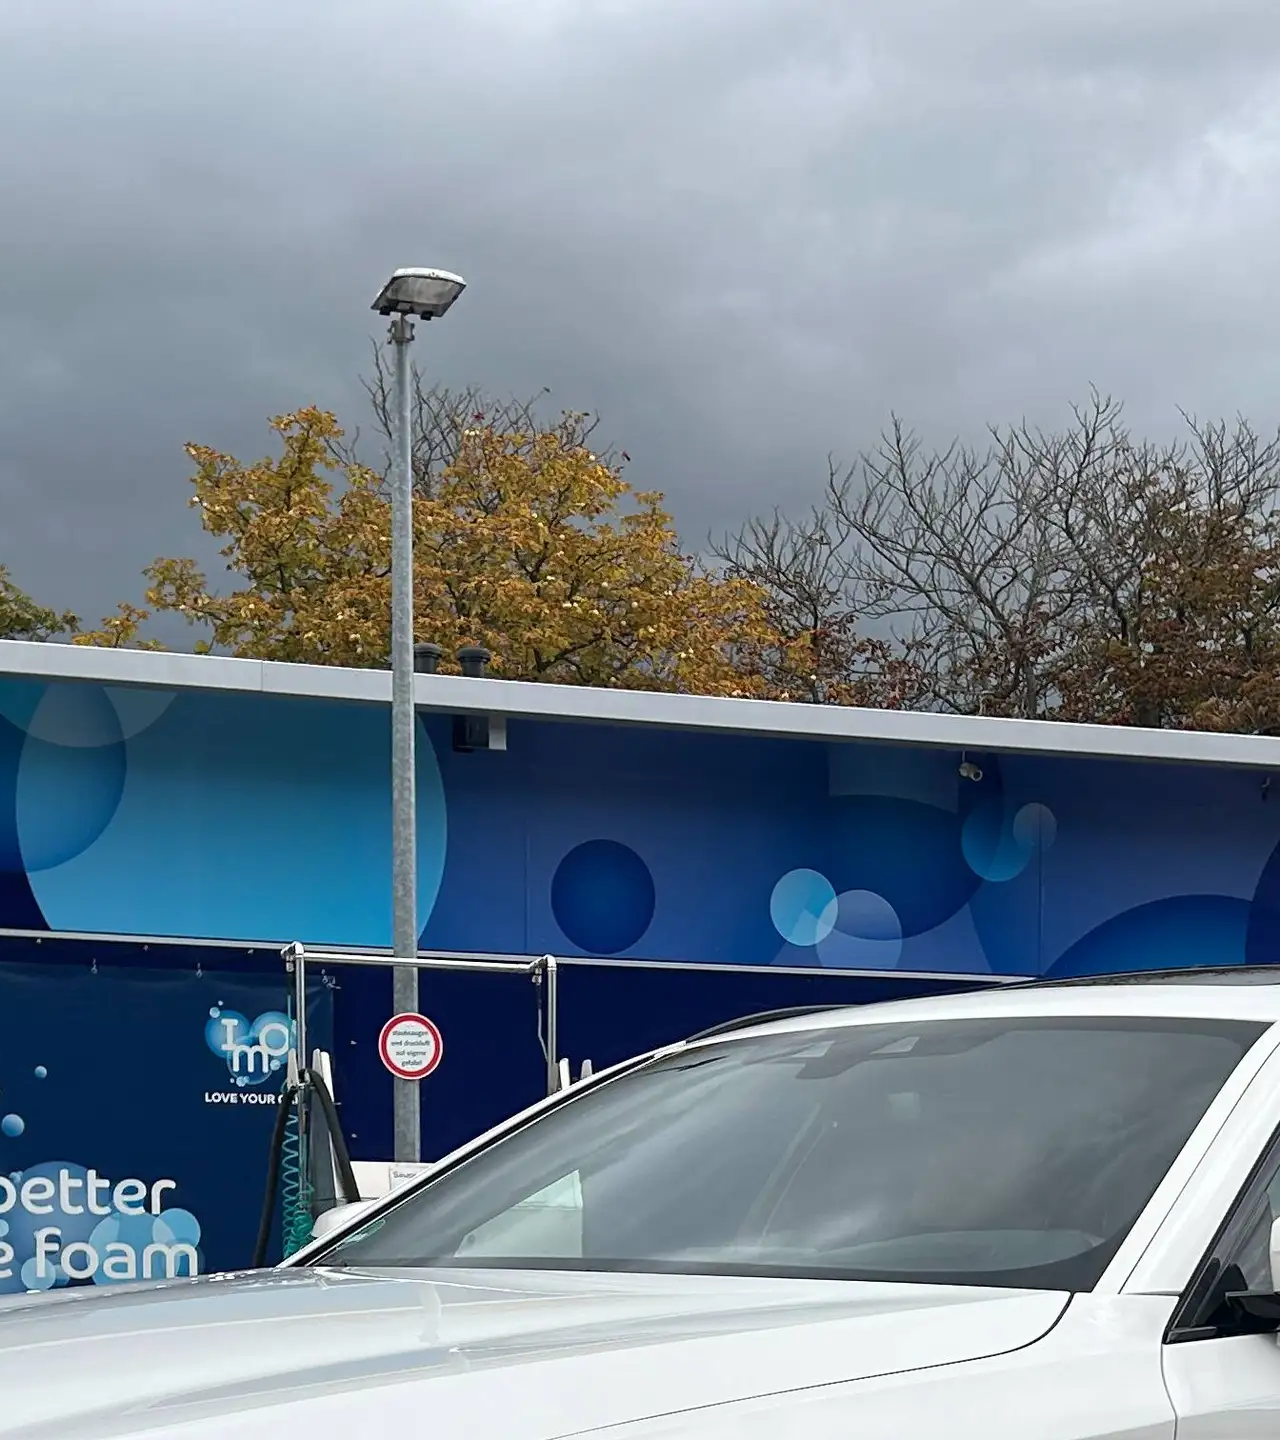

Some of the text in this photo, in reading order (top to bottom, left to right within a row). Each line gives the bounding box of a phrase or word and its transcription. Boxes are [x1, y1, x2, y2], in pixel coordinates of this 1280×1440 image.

[205, 1092, 238, 1104] LOVE
[240, 1093, 276, 1105] YOUR
[35, 1227, 198, 1279] foam
